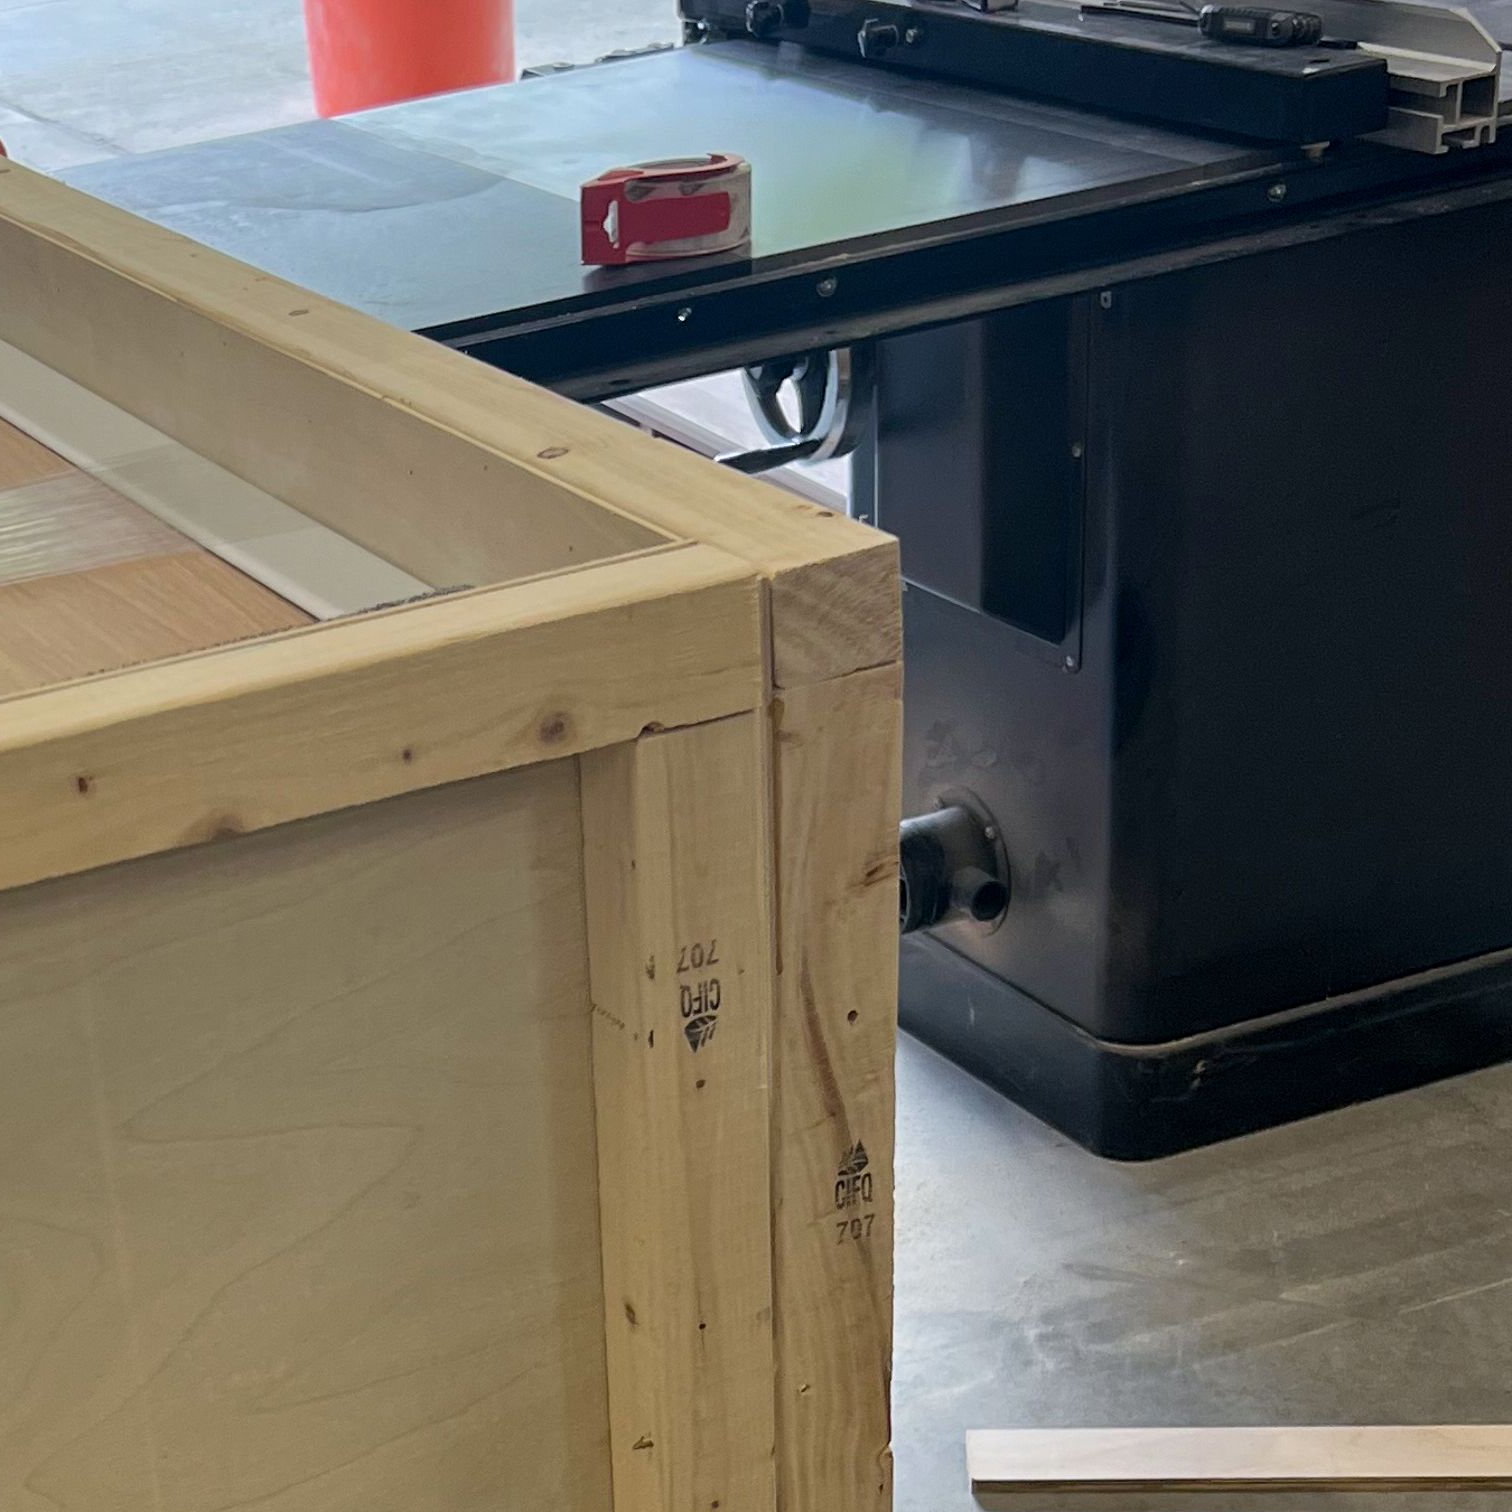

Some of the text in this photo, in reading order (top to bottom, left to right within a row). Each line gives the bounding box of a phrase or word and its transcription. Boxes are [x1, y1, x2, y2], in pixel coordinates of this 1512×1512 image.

[675, 938, 720, 975] 707
[679, 978, 722, 1019] CIFQ
[835, 1213, 876, 1246] 707
